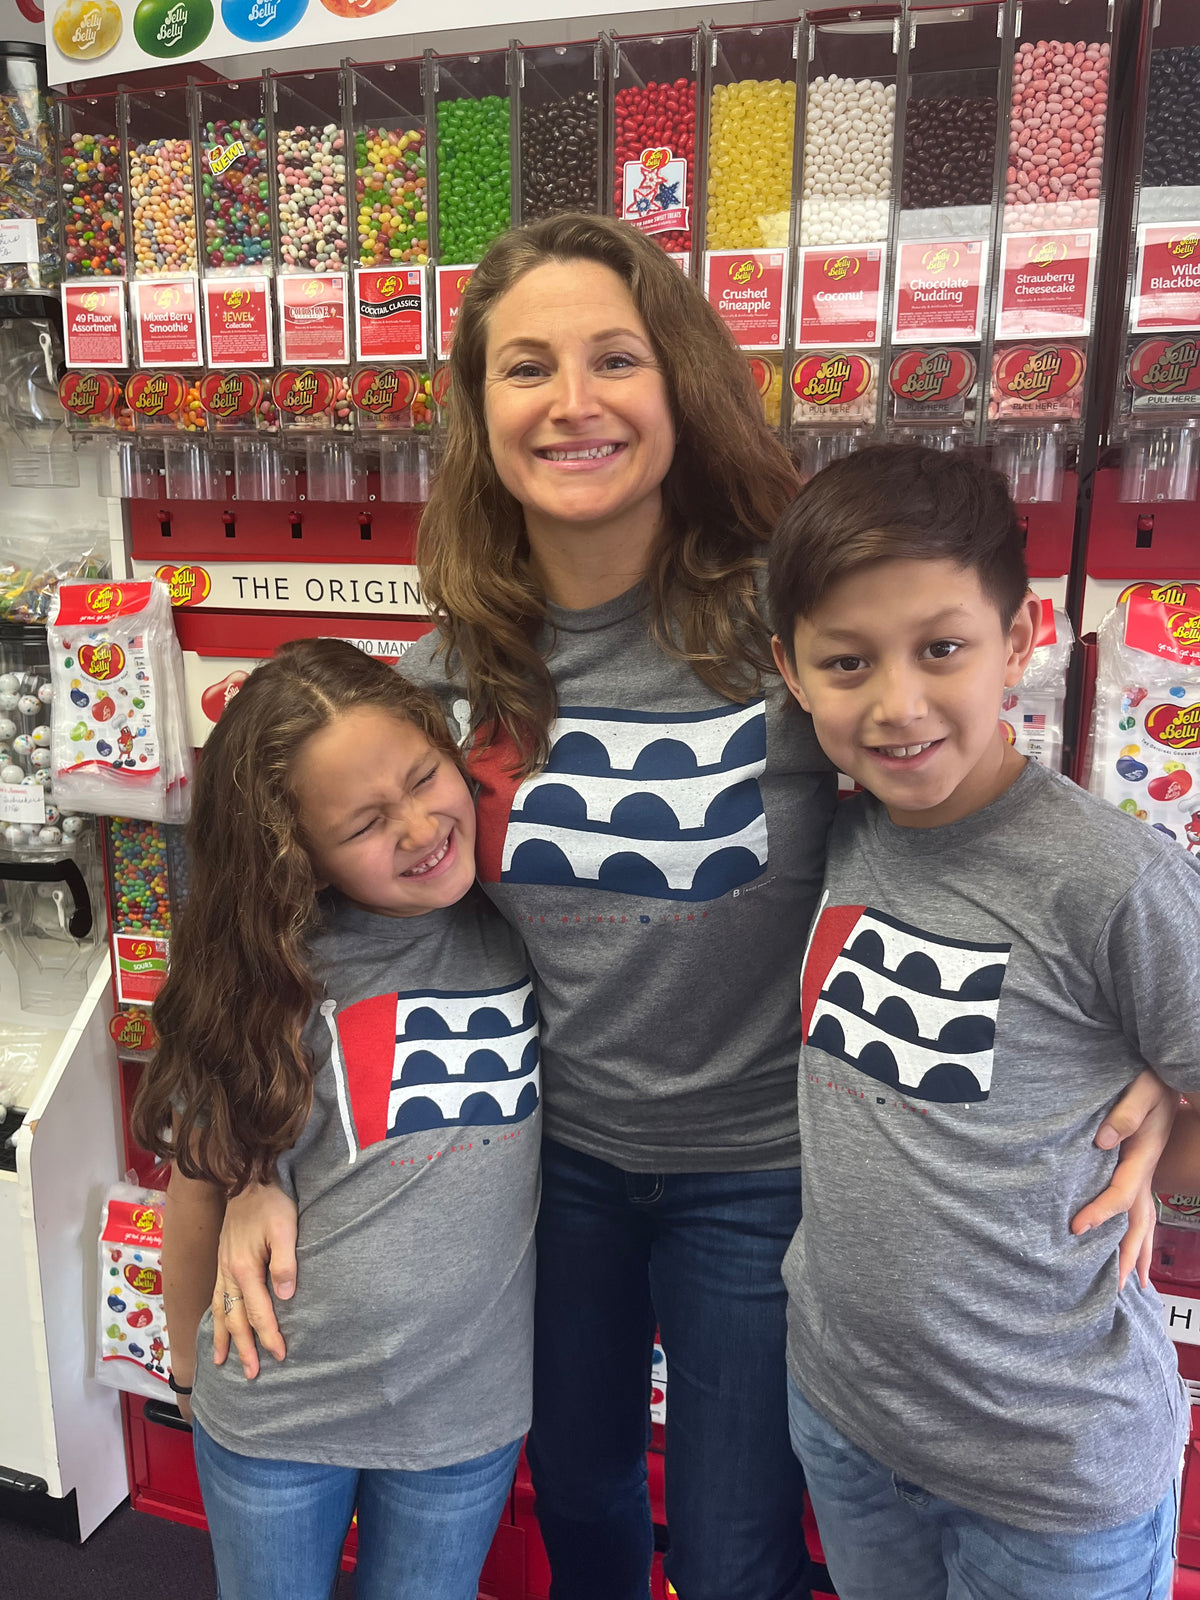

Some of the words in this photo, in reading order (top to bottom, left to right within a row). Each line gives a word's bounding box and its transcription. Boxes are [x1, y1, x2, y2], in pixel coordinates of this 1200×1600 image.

[81, 9, 102, 29] Jelly
[165, 2, 188, 25] Jelly
[248, 5, 277, 27] Belly
[72, 28, 97, 50] Belly
[157, 24, 183, 47] Belly
[211, 142, 244, 173] NEW!
[1173, 244, 1194, 258] Belly
[739, 261, 755, 274] Jelly
[834, 256, 851, 269] Jelly
[1171, 264, 1200, 276] Wild
[733, 272, 752, 285] Belly
[828, 267, 848, 281] Belly
[910, 277, 969, 290] Chocolate
[1016, 273, 1075, 286] Strawberry
[722, 288, 768, 300] Crushed
[816, 291, 864, 302] Coconut
[914, 290, 963, 304] Pudding
[1015, 284, 1076, 295] Cheesecake
[222, 311, 253, 322] JEWEL
[360, 305, 389, 315] COCKTAIL
[389, 299, 419, 310] CLASSICS
[719, 300, 771, 314] Pineapple
[75, 314, 86, 323] 49
[87, 313, 112, 323] Flavor
[143, 312, 169, 322] Mixed
[170, 311, 193, 324] Berry
[149, 322, 189, 333] Smoothie
[71, 323, 118, 333] Assortment
[1022, 348, 1062, 375] Jelly
[1159, 339, 1200, 367] Jelly
[816, 355, 851, 381] Jelly
[915, 350, 952, 377] Jelly
[76, 374, 100, 395] Jelly
[144, 373, 169, 395] Jelly
[218, 373, 243, 395] Jelly
[292, 371, 318, 393] Jelly
[370, 369, 398, 392] Jelly
[901, 374, 944, 401] Belly
[1007, 372, 1052, 400] Belly
[1142, 364, 1190, 393] Belly
[803, 376, 844, 405] Belly
[1147, 395, 1170, 403] PULL
[1171, 394, 1197, 403] HERE
[67, 392, 96, 414] Belly
[136, 392, 164, 415] Belly
[209, 393, 239, 416] Belly
[283, 391, 314, 414] Belly
[361, 391, 393, 414] Belly
[1035, 402, 1059, 410] HERE
[171, 565, 195, 587] Jelly
[169, 583, 191, 605] Belly
[232, 576, 289, 600] THE
[305, 578, 421, 604] ORIGIN
[92, 599, 111, 613] Belly
[92, 642, 112, 662] Jelly
[89, 661, 110, 680] Belly
[1159, 724, 1199, 748] Belly
[133, 961, 153, 970] SOURS
[124, 1018, 145, 1035] Jelly
[118, 1031, 142, 1049] Belly
[133, 1276, 153, 1294] Belly
